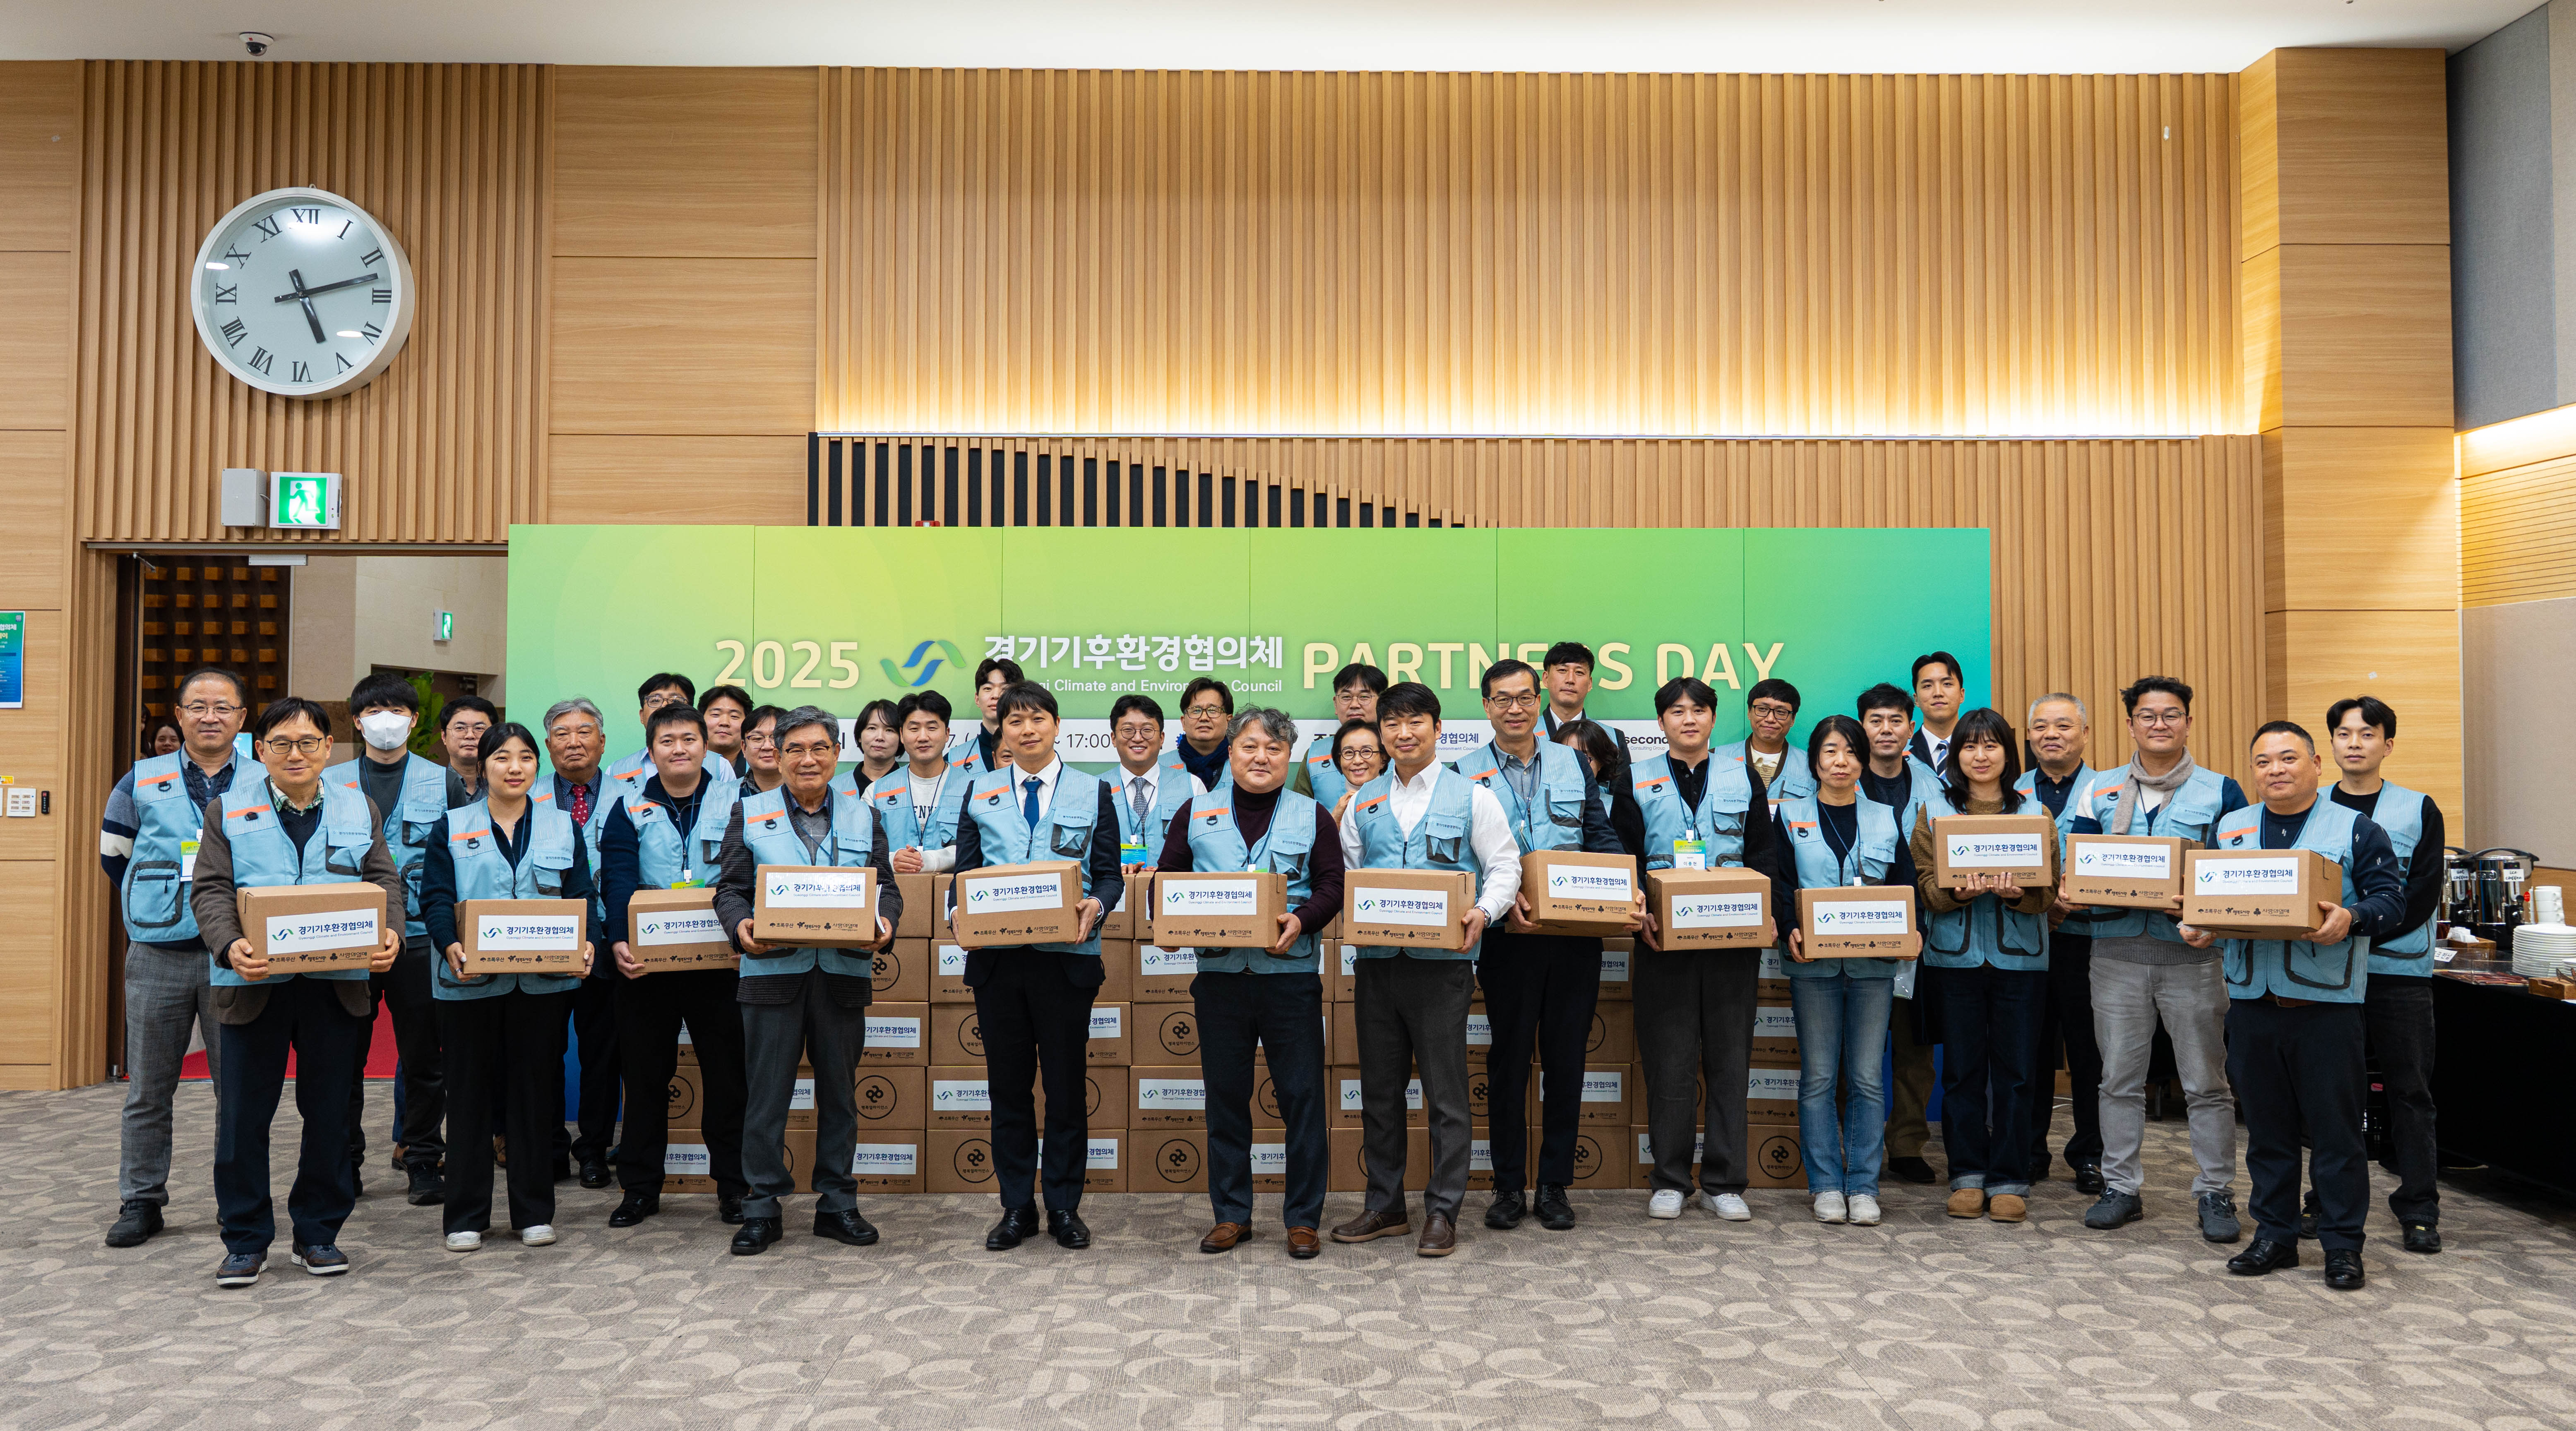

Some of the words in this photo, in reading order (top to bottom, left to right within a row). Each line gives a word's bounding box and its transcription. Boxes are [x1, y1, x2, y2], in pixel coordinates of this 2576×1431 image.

[252, 214, 282, 243] XI
[337, 219, 353, 240] I
[224, 243, 251, 269] X
[360, 247, 384, 268] II
[372, 288, 392, 305] III
[336, 352, 354, 375] V
[714, 640, 859, 689] 2025
[985, 634, 1282, 672] 경기기후환경협의체
[1304, 643, 1633, 690] PARTNES
[1657, 643, 1784, 689] DAY
[1055, 679, 1106, 691] Climate
[1111, 679, 1140, 691] and
[1231, 679, 1282, 692] Council
[1067, 734, 1111, 748] 17:00
[2223, 869, 2292, 878] 경기기후환경협의체
[1572, 876, 1627, 886] 경기기후환경협의체
[993, 885, 1057, 896] 경기기후환경협의체
[1379, 900, 1443, 909] 경기기후환경협의체
[1697, 904, 1757, 912] 경기기후환경협의체
[298, 921, 372, 934] 경기기후환경협의체
[664, 920, 721, 929] 경기기후환경협의
